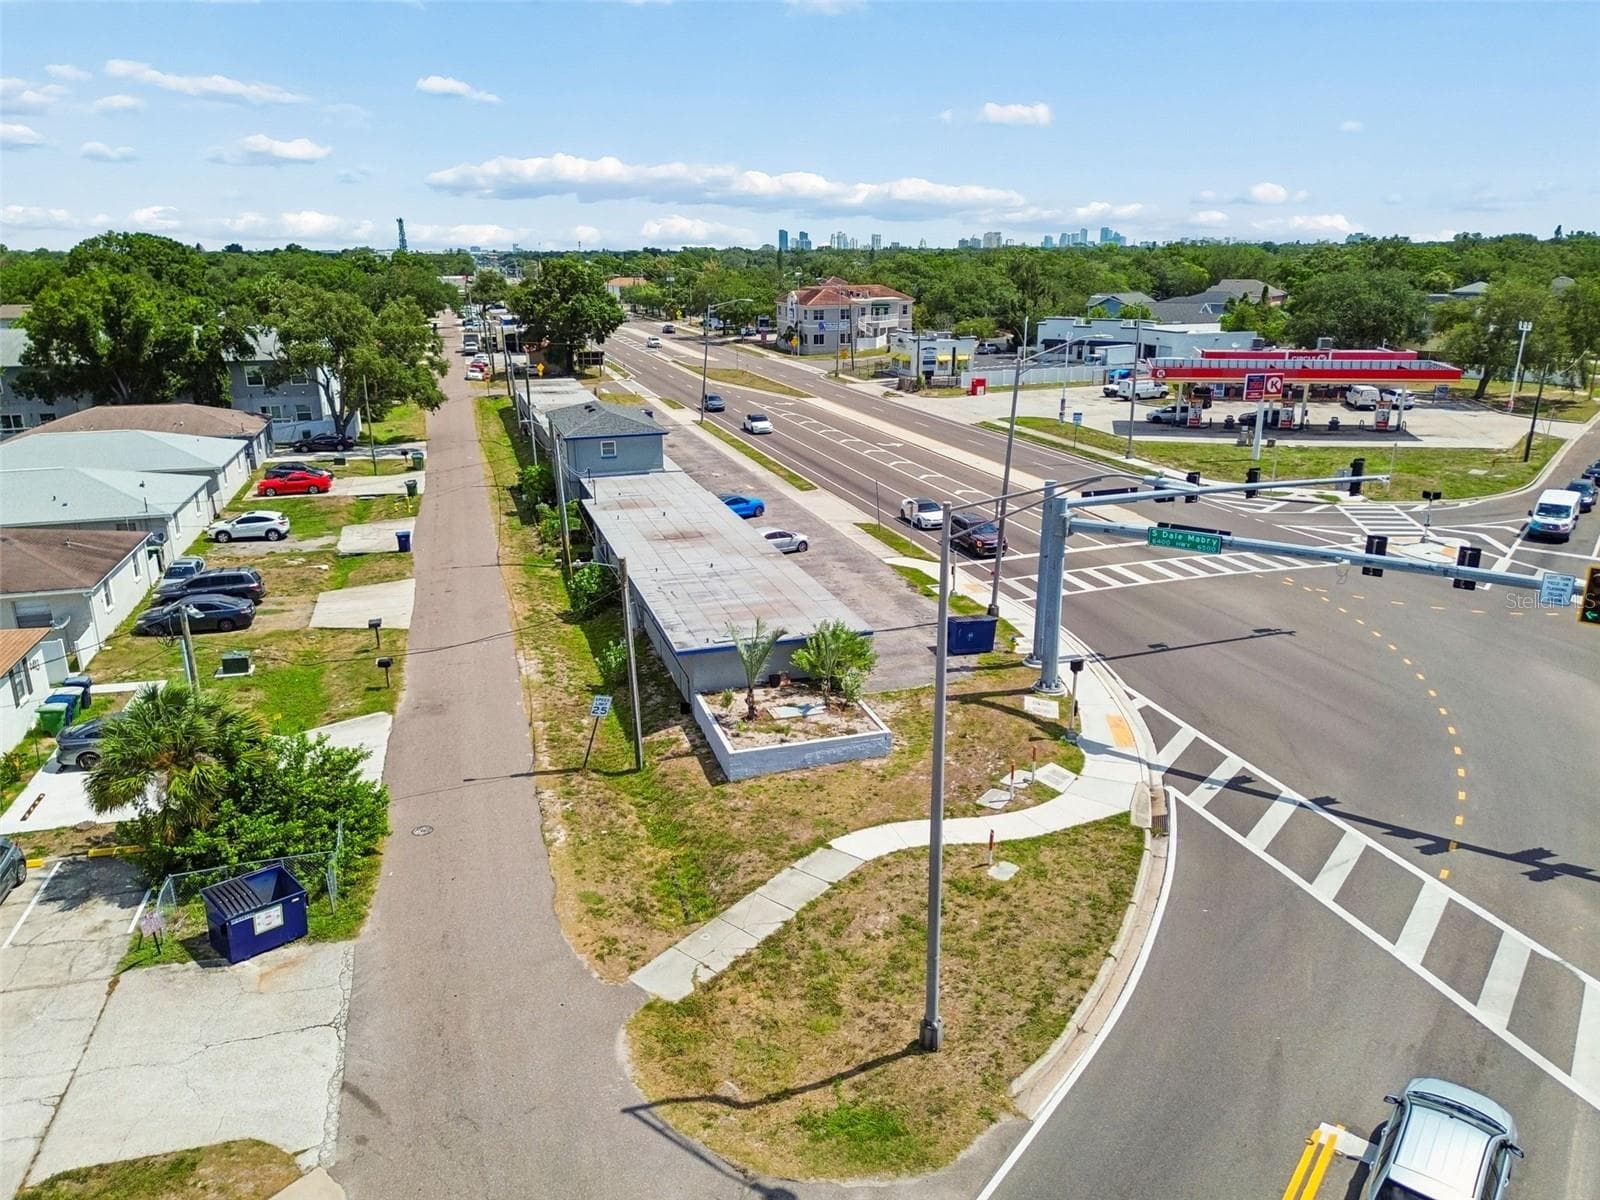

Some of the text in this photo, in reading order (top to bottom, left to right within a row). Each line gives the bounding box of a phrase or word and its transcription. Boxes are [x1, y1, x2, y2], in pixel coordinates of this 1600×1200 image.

[1162, 531, 1183, 540] Dale
[1188, 534, 1217, 546] Mabry
[592, 706, 607, 714] 25
